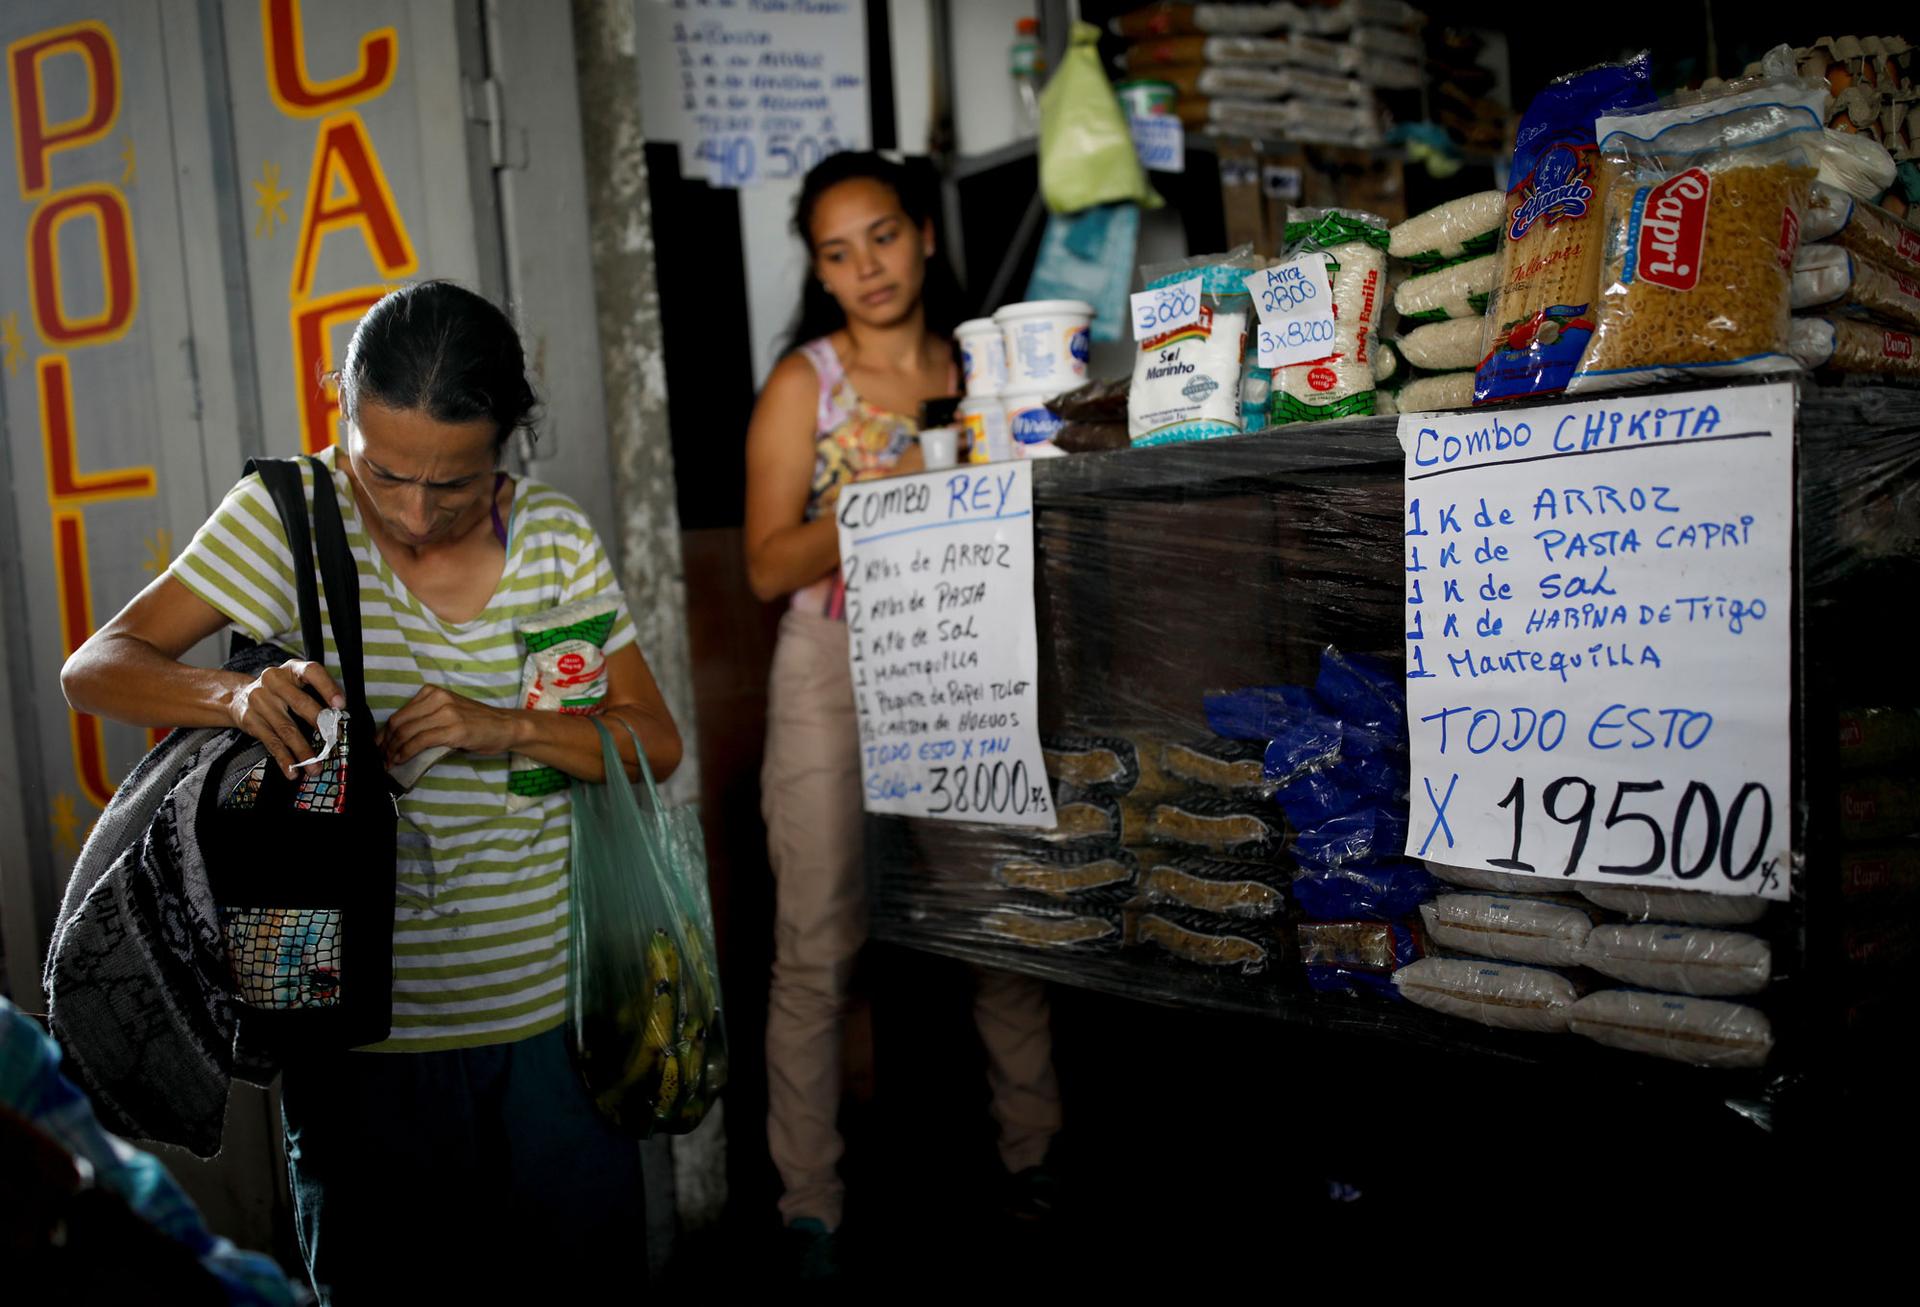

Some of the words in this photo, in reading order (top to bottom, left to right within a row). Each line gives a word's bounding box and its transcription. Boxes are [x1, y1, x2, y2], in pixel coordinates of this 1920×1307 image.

[1510, 178, 1593, 240] Eduardo
[1641, 176, 1705, 276] Capri
[1138, 294, 1196, 329] 3000
[1360, 268, 1378, 323] Emilia
[1146, 362, 1195, 381] Marinho
[1415, 418, 1532, 467] Combo
[841, 483, 930, 529] COMBO
[946, 470, 1016, 520] REY
[1405, 498, 1428, 536] 1
[1439, 503, 1462, 534] K
[1473, 498, 1515, 527] de
[1533, 485, 1680, 521] ARROZ
[845, 555, 860, 592] 2
[911, 549, 931, 573] de
[940, 543, 1011, 575] ARROZ
[1406, 546, 1428, 572] 1
[1439, 541, 1462, 568] K
[1474, 536, 1510, 564] de
[1534, 527, 1642, 563] PASTA
[849, 600, 863, 633] 2
[909, 590, 926, 608] de
[934, 582, 987, 612] PASTA
[1407, 578, 1424, 604] 1
[1443, 578, 1464, 603] K
[1479, 573, 1513, 601] de
[1406, 610, 1424, 640] 1
[1443, 613, 1459, 638] K
[1476, 608, 1503, 638] de
[1639, 604, 1672, 625] DE
[1675, 596, 1767, 635] Trigo
[853, 640, 864, 662] 1
[911, 628, 929, 648] de
[1406, 645, 1437, 678] 1
[958, 711, 1020, 733] HUEVOS
[1420, 706, 1567, 755] TODO
[1588, 703, 1713, 751] ESTO
[864, 743, 912, 768] TODO
[917, 740, 957, 761] ESTO
[979, 737, 1011, 757] TAN
[927, 759, 1029, 815] 38000
[1417, 773, 1459, 856] X
[1486, 775, 1773, 881] 19500
